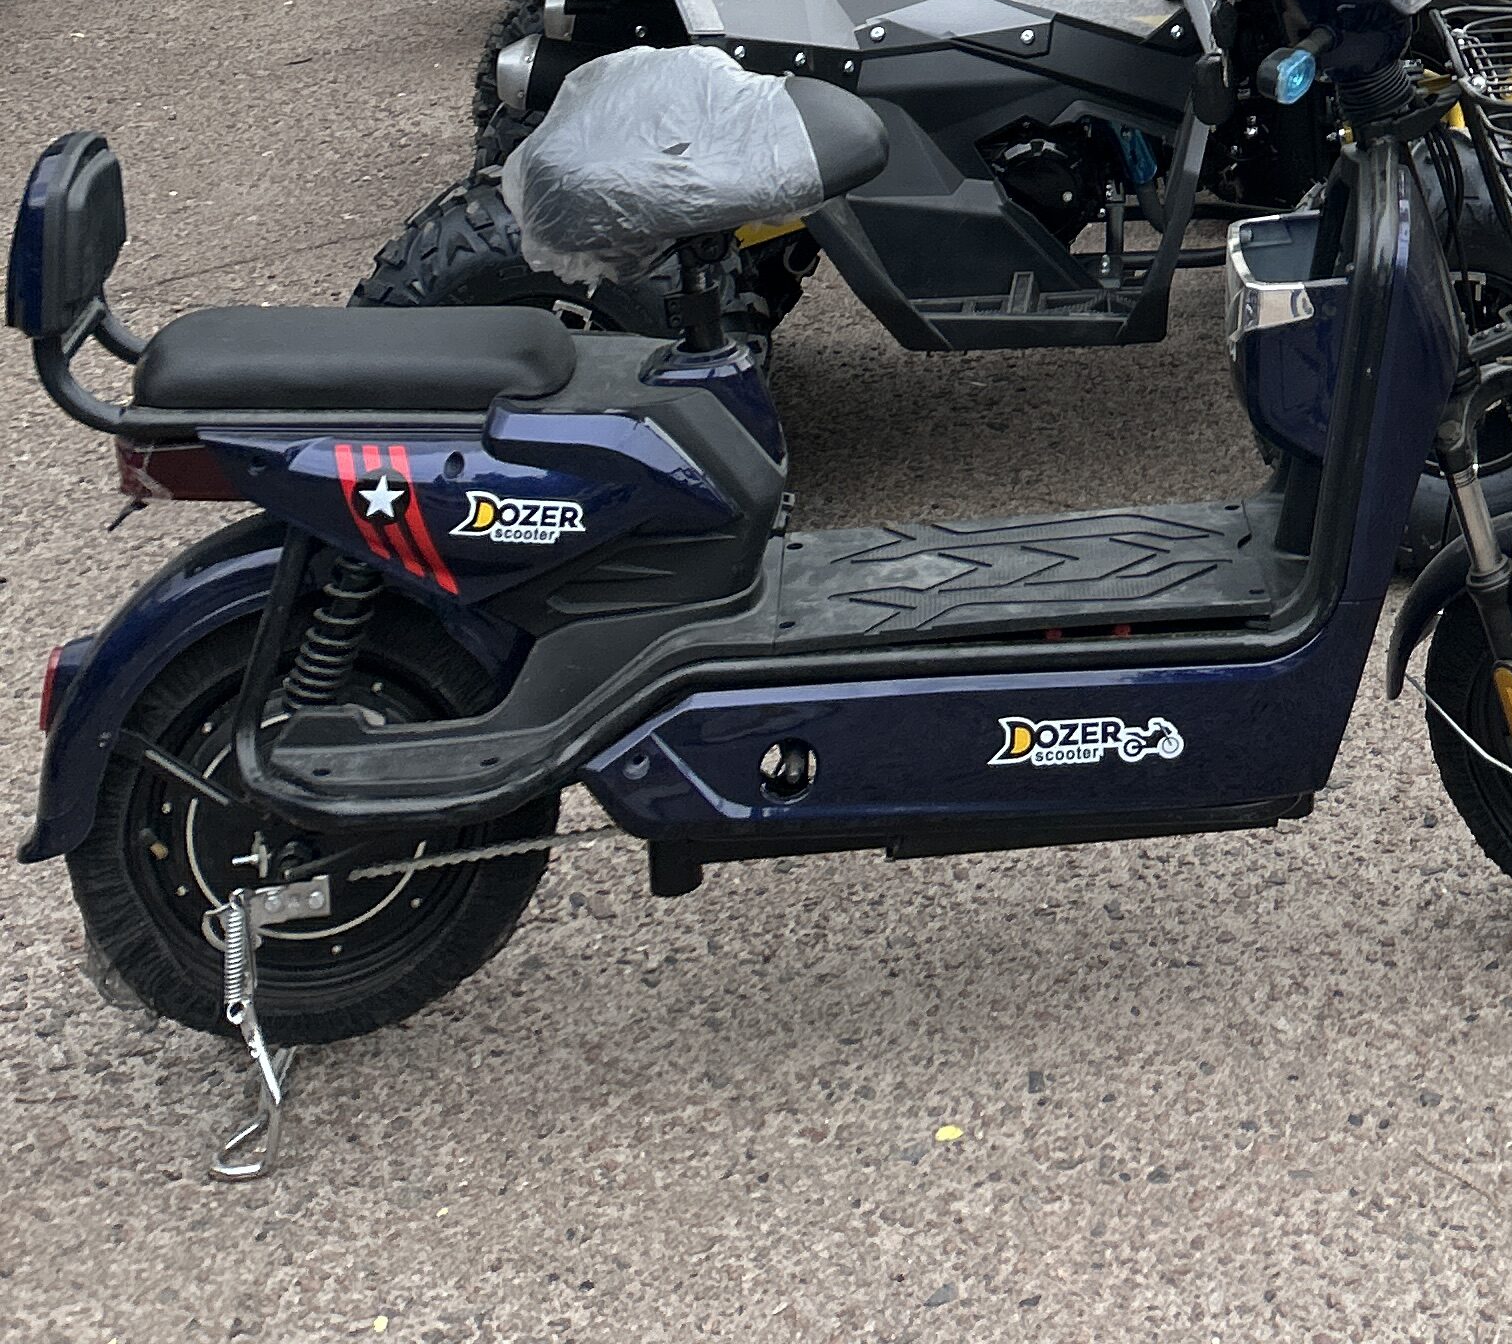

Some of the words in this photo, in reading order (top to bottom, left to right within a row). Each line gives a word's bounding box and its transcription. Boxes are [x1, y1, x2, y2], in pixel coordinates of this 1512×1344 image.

[455, 493, 581, 534] DOZER
[494, 528, 556, 541] scooter
[994, 719, 1123, 761] DOZER
[1034, 746, 1099, 762] scooter
